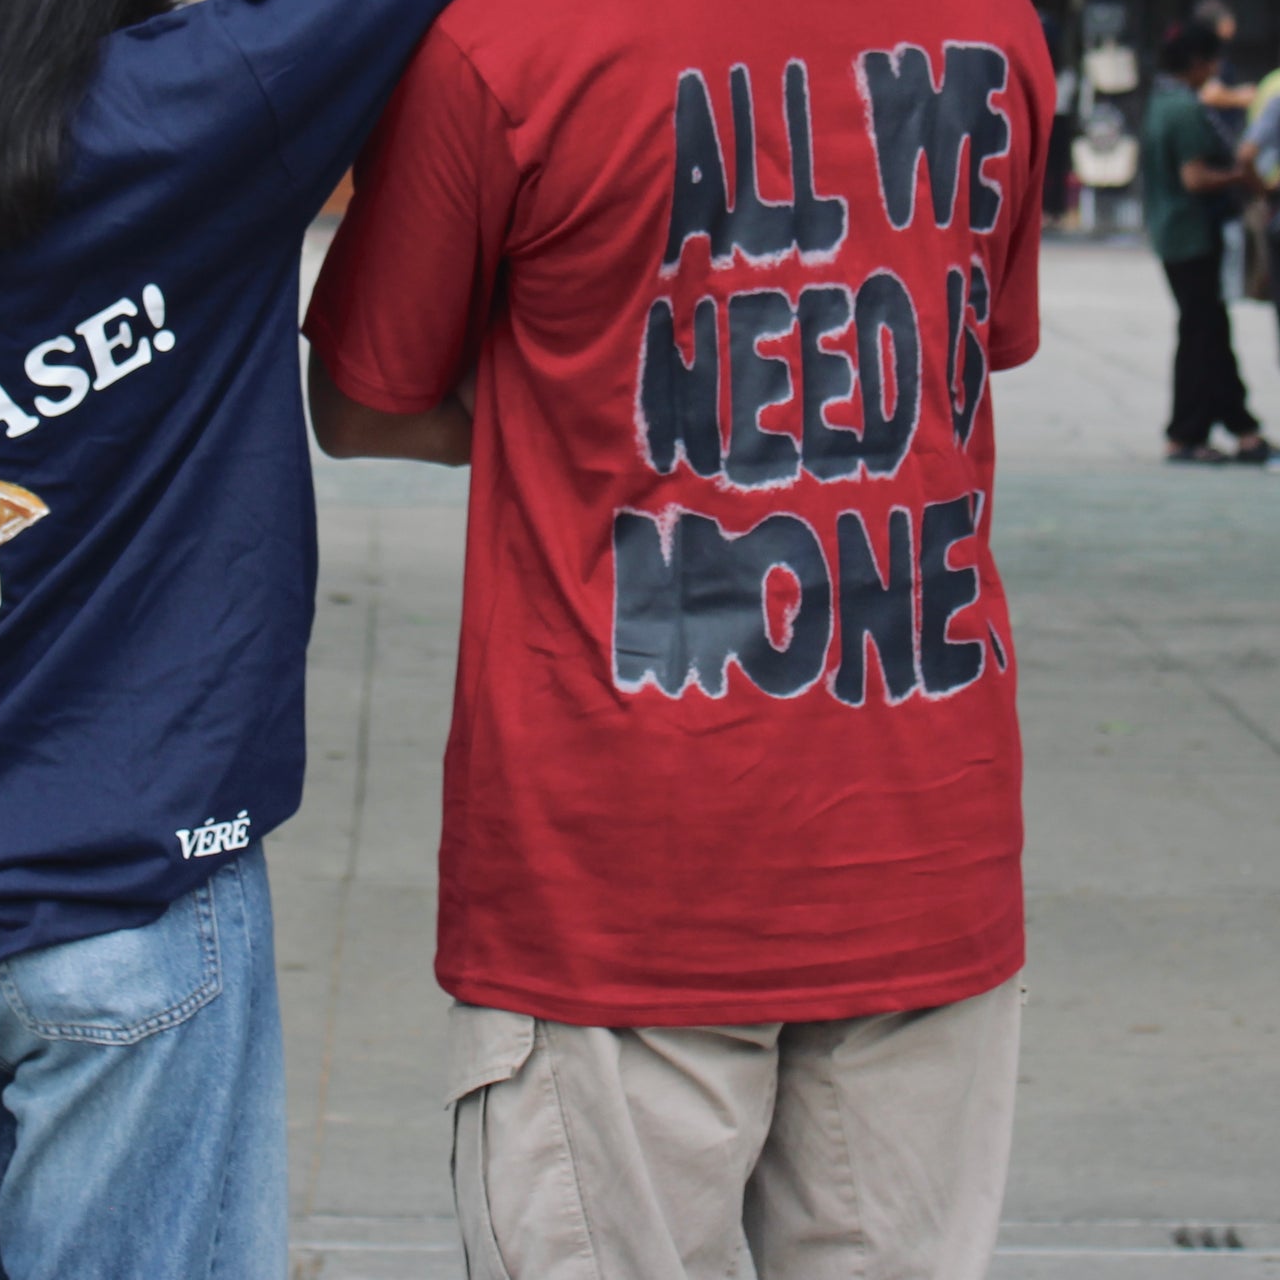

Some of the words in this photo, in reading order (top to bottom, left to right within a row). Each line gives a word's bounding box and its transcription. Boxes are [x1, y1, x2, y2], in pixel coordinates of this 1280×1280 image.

[658, 57, 848, 280] ALL
[853, 39, 1010, 234] WE
[634, 267, 922, 491] NEED
[611, 490, 1008, 708] MONE
[175, 809, 251, 860] VÉRÉ
